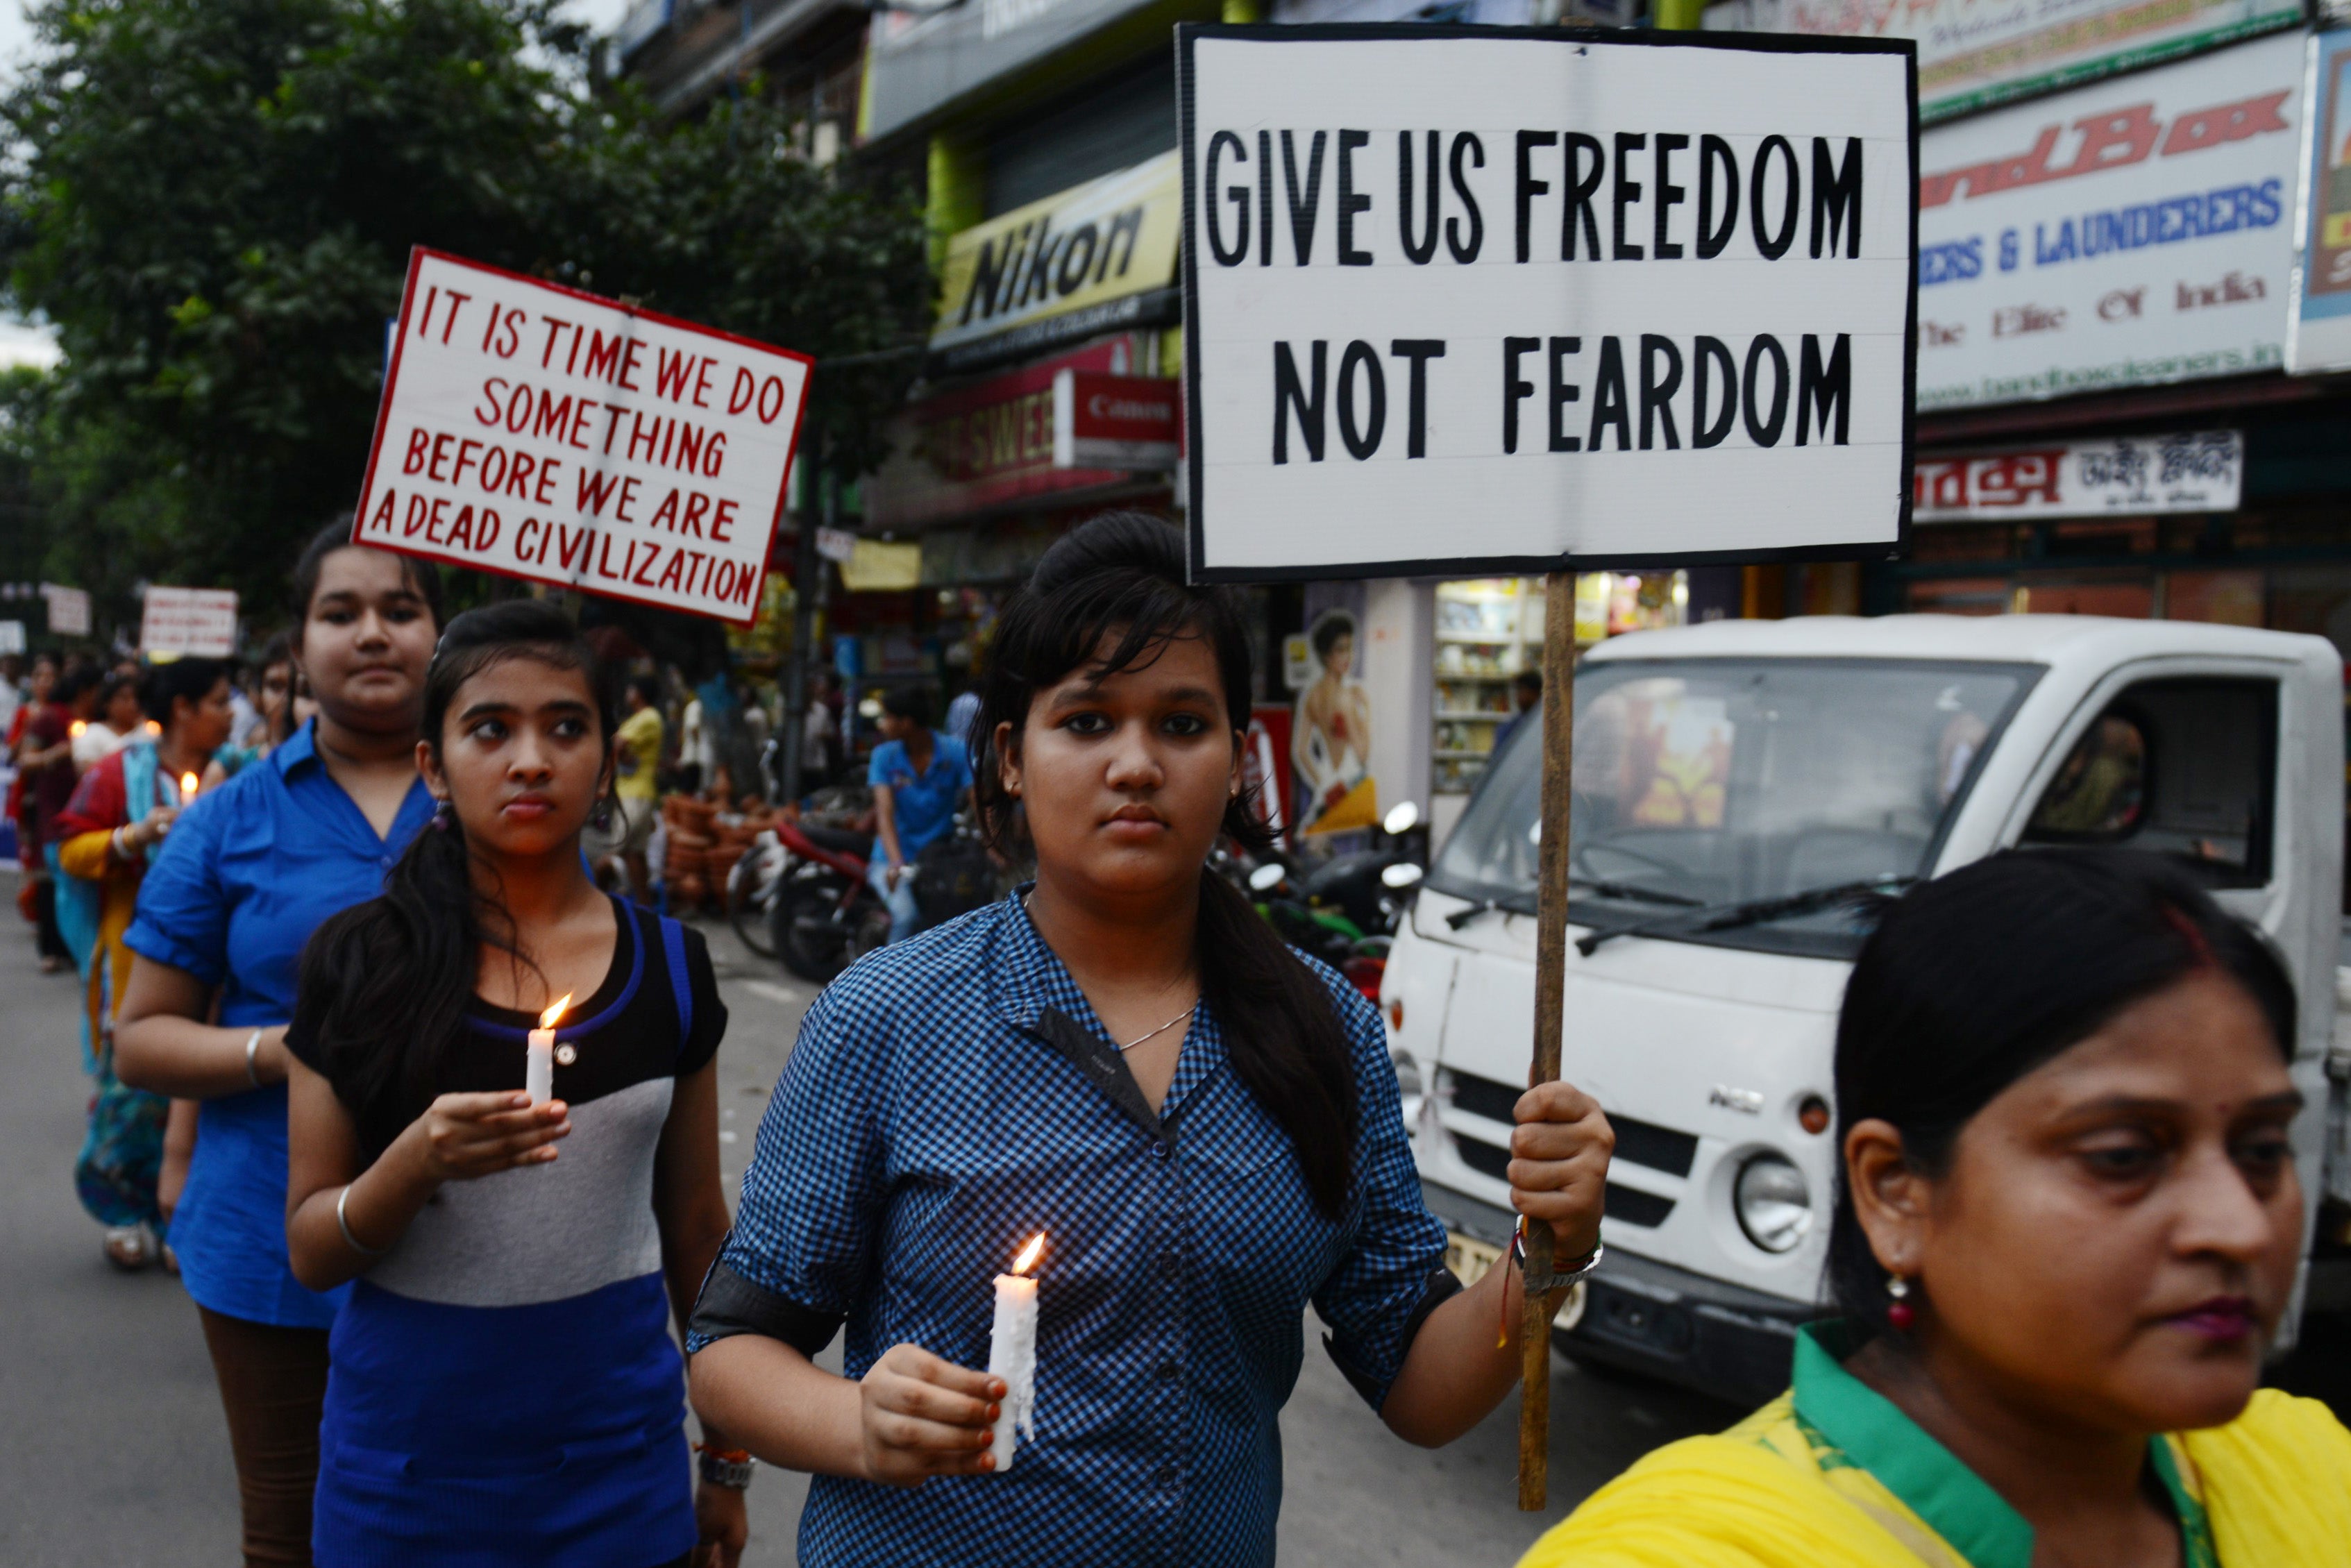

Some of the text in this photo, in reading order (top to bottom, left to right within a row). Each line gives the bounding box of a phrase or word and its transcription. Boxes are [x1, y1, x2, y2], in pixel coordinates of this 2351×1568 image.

[1206, 128, 1863, 267] GIVE US FREEDOM
[1998, 228, 2021, 274] &
[2034, 177, 2284, 268] LAUNDERERS
[960, 206, 1143, 326] Nikon
[1991, 300, 2067, 339] Elite
[2174, 268, 2267, 312] India
[419, 287, 785, 425] IT IS TIME WE DO
[1088, 393, 1172, 421] Canon
[1272, 332, 1851, 466] NOT FEARDOM
[402, 427, 740, 543] BEFORE WE ARE
[474, 378, 728, 478] SOMETHING
[371, 488, 396, 533] A
[403, 493, 502, 553] DEAD
[514, 518, 758, 606] CIVILIZATION
